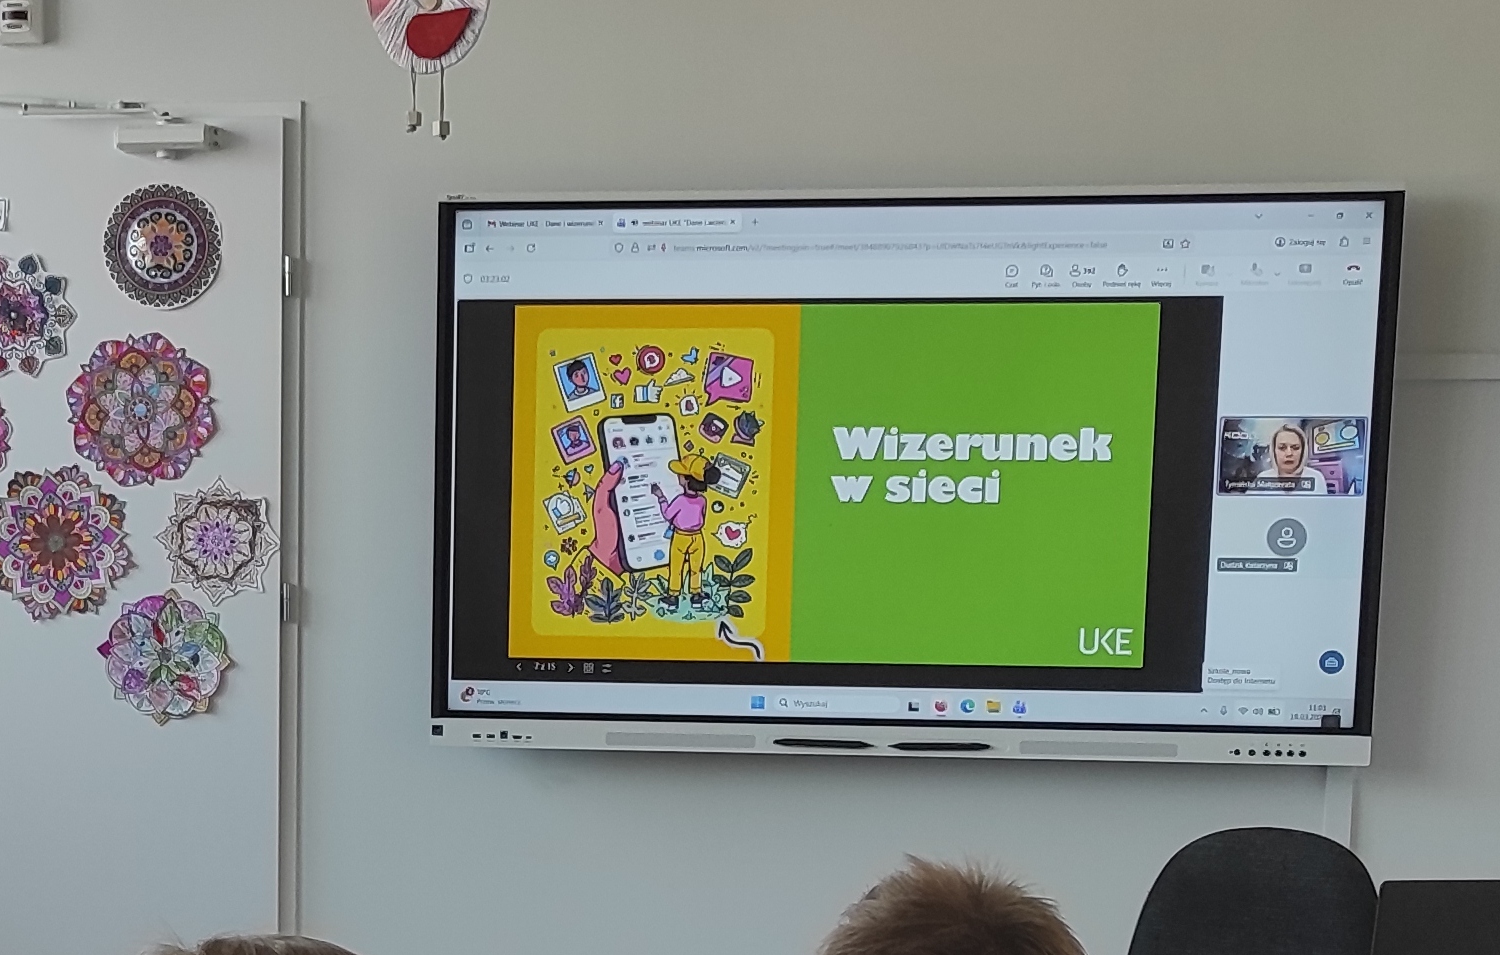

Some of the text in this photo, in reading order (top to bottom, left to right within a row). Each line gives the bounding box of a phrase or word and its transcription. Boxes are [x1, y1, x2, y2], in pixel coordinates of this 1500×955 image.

[832, 425, 1113, 463] Wizerunek
[830, 468, 1001, 504] w sieci
[1078, 627, 1134, 656] UKE
